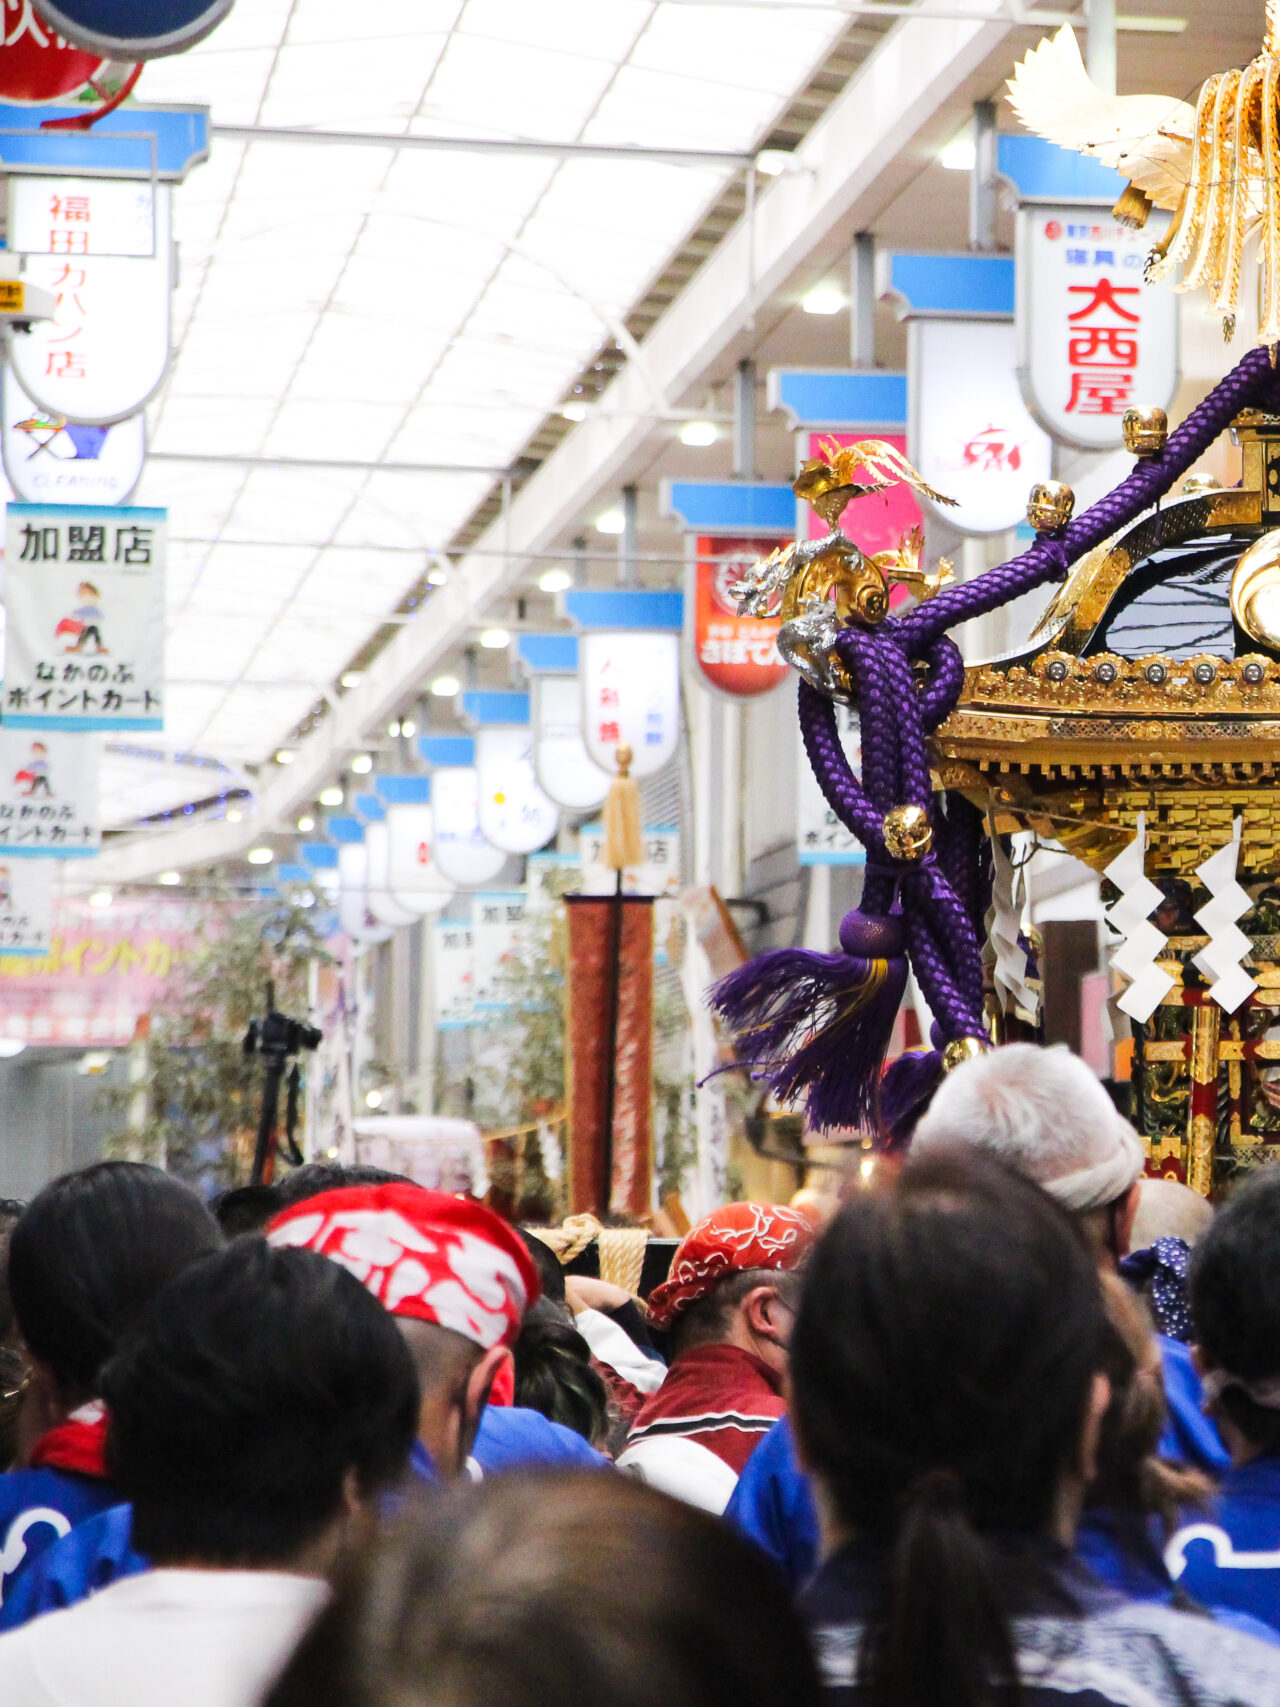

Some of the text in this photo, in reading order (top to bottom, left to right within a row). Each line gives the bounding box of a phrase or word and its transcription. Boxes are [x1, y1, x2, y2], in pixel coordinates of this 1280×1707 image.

[1064, 278, 1141, 415] 大西屋
[19, 523, 155, 564] 加盟店
[35, 662, 135, 684] なかのぶ
